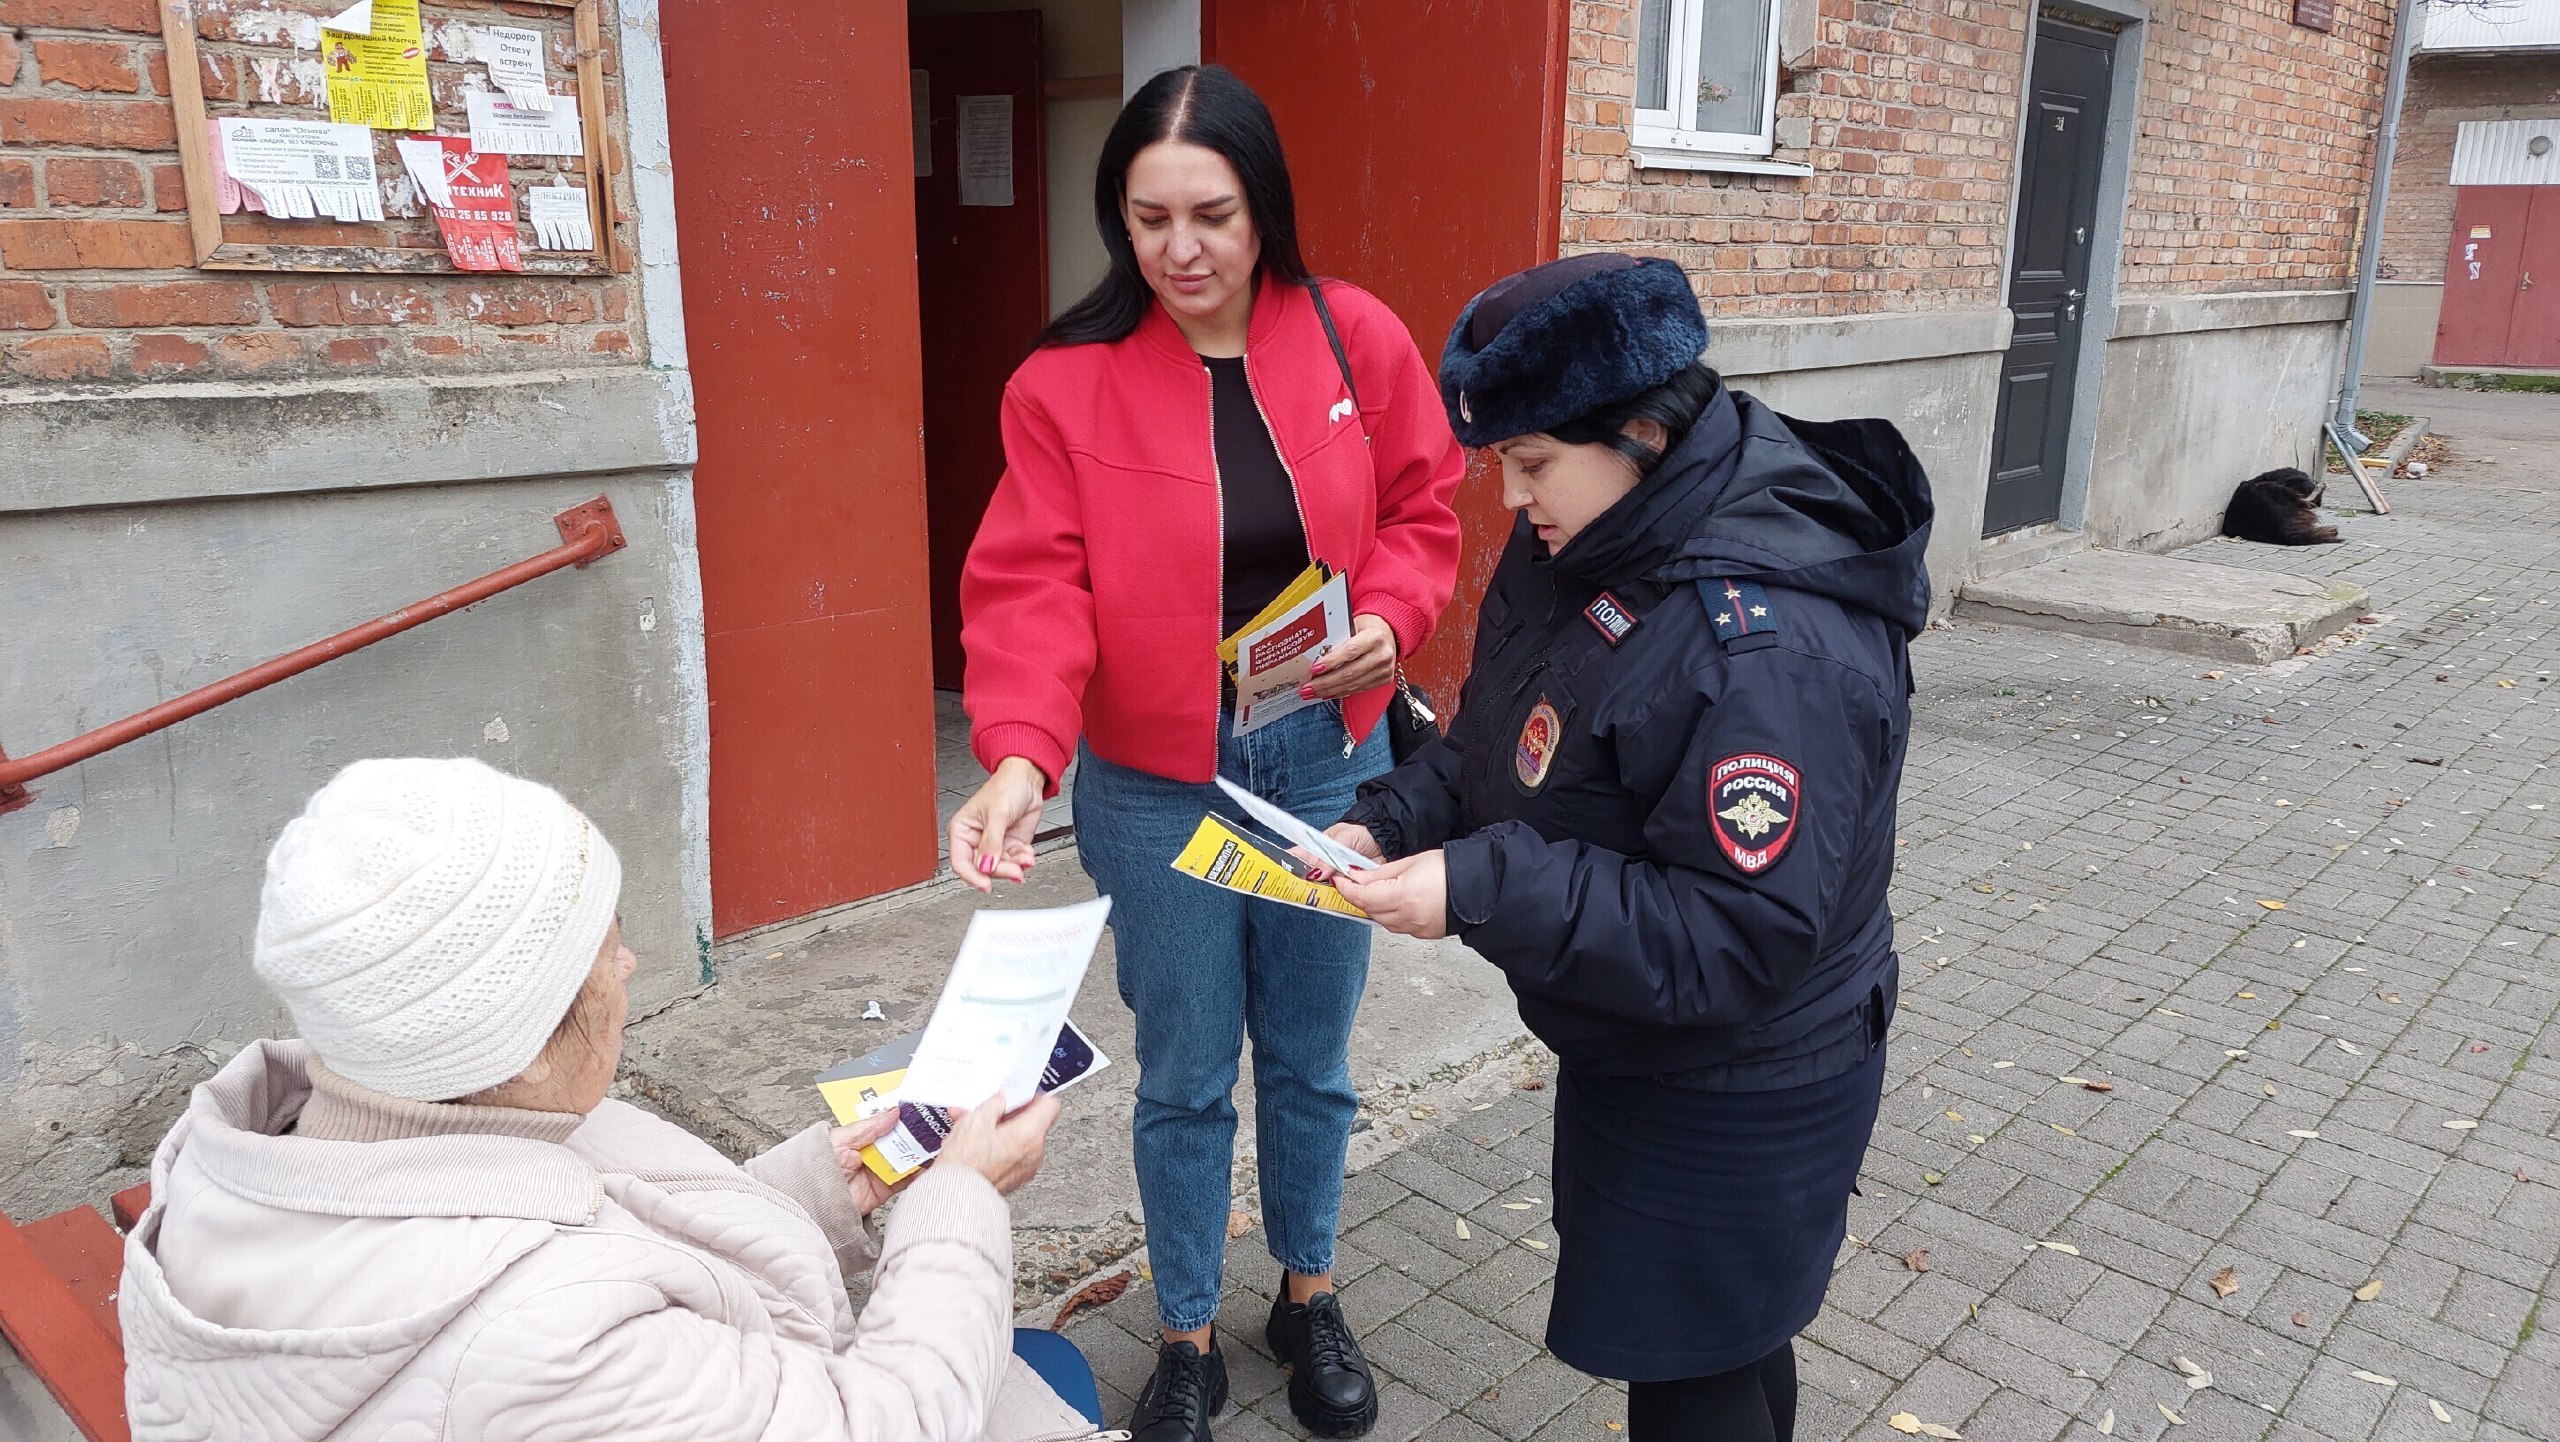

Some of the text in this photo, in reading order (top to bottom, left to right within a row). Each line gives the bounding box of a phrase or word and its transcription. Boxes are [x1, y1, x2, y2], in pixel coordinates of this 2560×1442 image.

[326, 31, 417, 45] Ваш Домашний Мастер
[493, 29, 536, 42] Недорого
[500, 43, 531, 56] Отвезу
[499, 58, 533, 69] встречу
[264, 126, 291, 134] салон
[533, 191, 582, 201] ЭЛЕКТРИК
[473, 210, 488, 220] 85
[490, 210, 512, 221] 928
[1255, 627, 1308, 660] РАСПОЗНАТЬ
[1255, 640, 1273, 653] КАК
[1255, 629, 1315, 665] ФИНАНСОВУЮ
[1255, 644, 1302, 672] ПИРАМИДУ
[1716, 758, 1795, 786] ПОЛИЦИЯ
[1722, 776, 1787, 802] РОССИЯ
[1734, 846, 1768, 869] МВД
